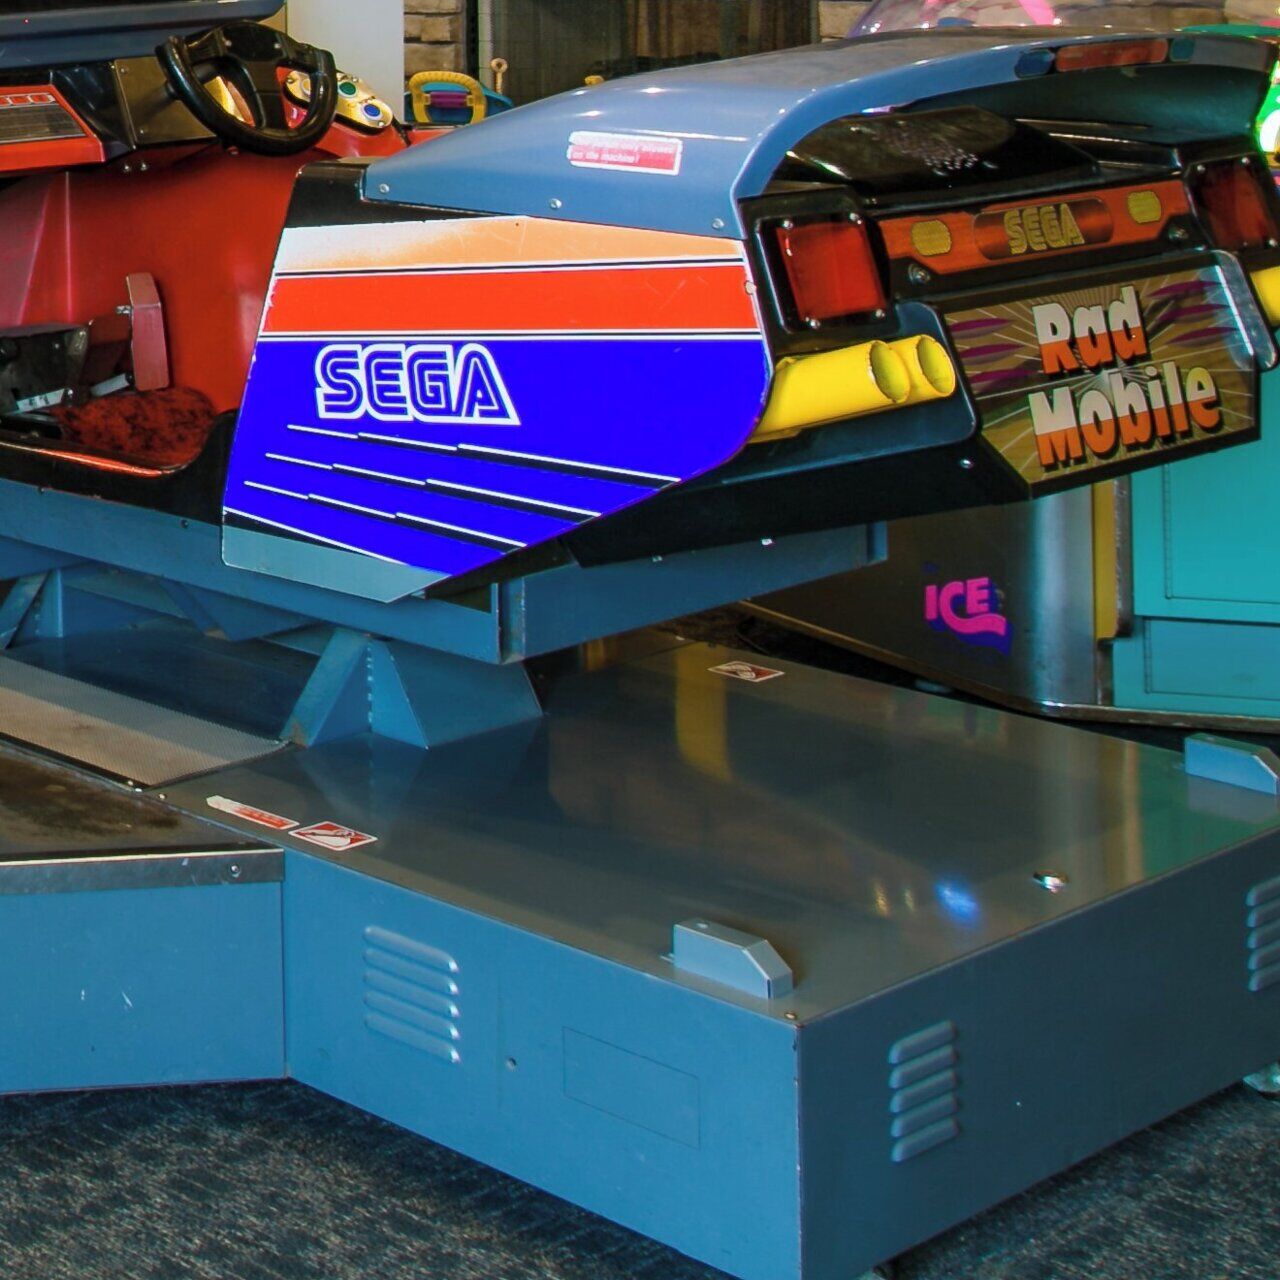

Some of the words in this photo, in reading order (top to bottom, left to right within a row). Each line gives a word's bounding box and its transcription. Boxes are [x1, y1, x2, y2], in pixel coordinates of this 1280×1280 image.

[1003, 203, 1087, 256] SEGA
[1031, 285, 1149, 376] Rad
[313, 342, 522, 427] SEGA
[1029, 361, 1221, 469] Mobile
[924, 575, 1008, 637] ICE
